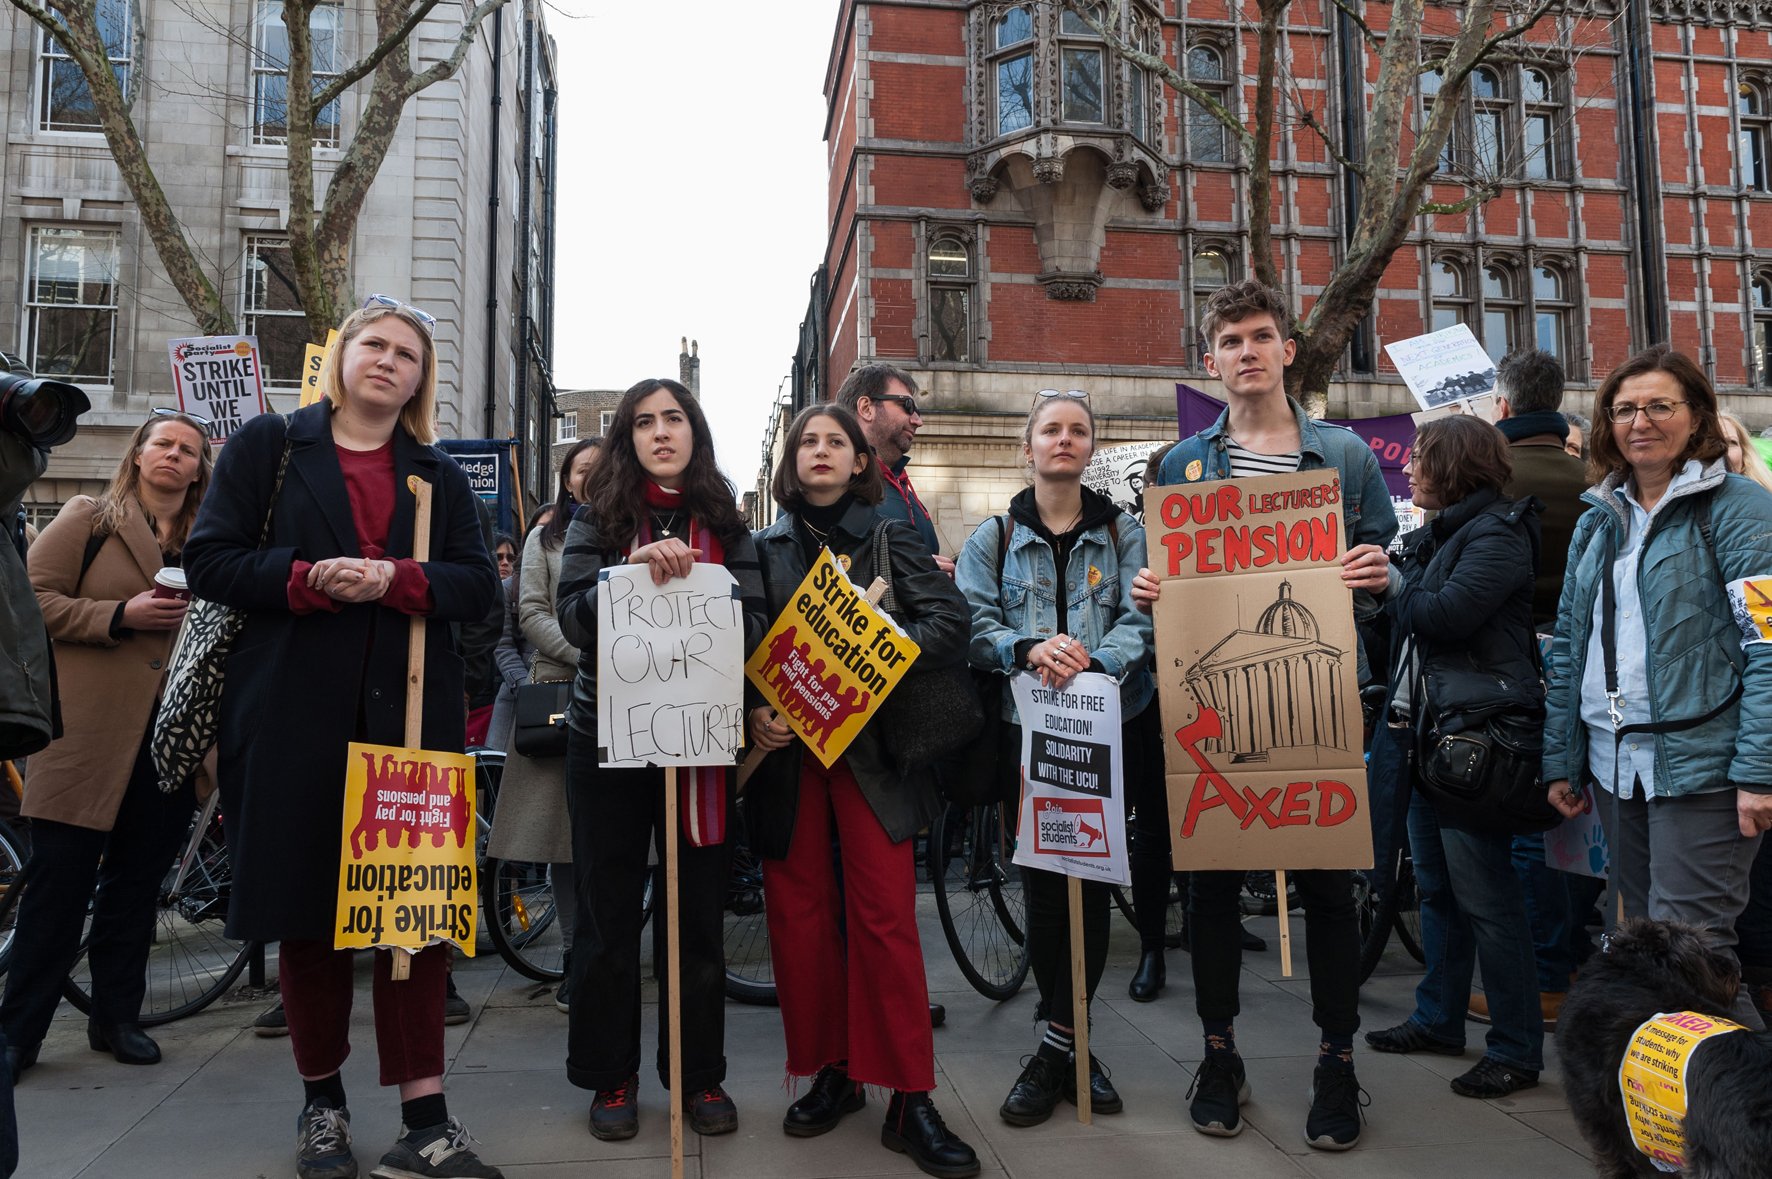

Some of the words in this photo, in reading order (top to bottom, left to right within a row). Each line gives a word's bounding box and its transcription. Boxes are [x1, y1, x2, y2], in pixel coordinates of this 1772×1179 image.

[186, 344, 231, 352] Socialist
[183, 358, 254, 382] STRIKE
[192, 379, 251, 401] UNTIL
[209, 399, 241, 419] WE
[1104, 447, 1118, 455] LIFE
[1112, 452, 1138, 463] CAREER
[461, 462, 494, 476] ledge
[1081, 470, 1120, 483] UNIVERSITY
[468, 476, 495, 488] nion
[1110, 477, 1121, 485] TO
[1160, 485, 1243, 530] OUR
[1160, 512, 1339, 577] PENSION
[607, 576, 736, 630] PROTECT
[813, 563, 869, 636] Strike
[869, 626, 907, 669] for
[796, 592, 888, 696] education
[611, 632, 732, 683] OUR
[781, 661, 795, 683] and
[793, 678, 832, 720] pensions
[788, 649, 810, 680] Fight
[807, 674, 823, 693] for
[820, 688, 840, 711] pay
[1031, 689, 1060, 707] STRIKE
[1061, 692, 1078, 709] FOR
[1080, 695, 1105, 712] FREE
[1045, 713, 1093, 736] EDUCATION!
[1045, 740, 1092, 764] SOLIDARITY
[1038, 762, 1058, 780] WITH
[1058, 766, 1074, 785] THE
[1075, 770, 1099, 790] UCU!
[376, 789, 426, 807] pensions
[429, 794, 451, 810] and
[1179, 768, 1358, 839] AXED
[375, 804, 396, 821] pay
[399, 810, 417, 827] for
[420, 808, 451, 828] Fight
[1041, 820, 1074, 833] socialist
[1041, 831, 1078, 844] students
[346, 863, 472, 901] education
[342, 899, 384, 944] for
[394, 904, 472, 942] Strike
[1649, 1026, 1678, 1043] message
[1676, 1036, 1688, 1046] for
[1635, 1035, 1666, 1053] students:
[1665, 1047, 1681, 1062] why
[1630, 1049, 1640, 1059] we
[1640, 1053, 1651, 1064] are
[1651, 1058, 1679, 1079] striking
[1640, 1128, 1654, 1141] for
[1654, 1133, 1685, 1150] essage
